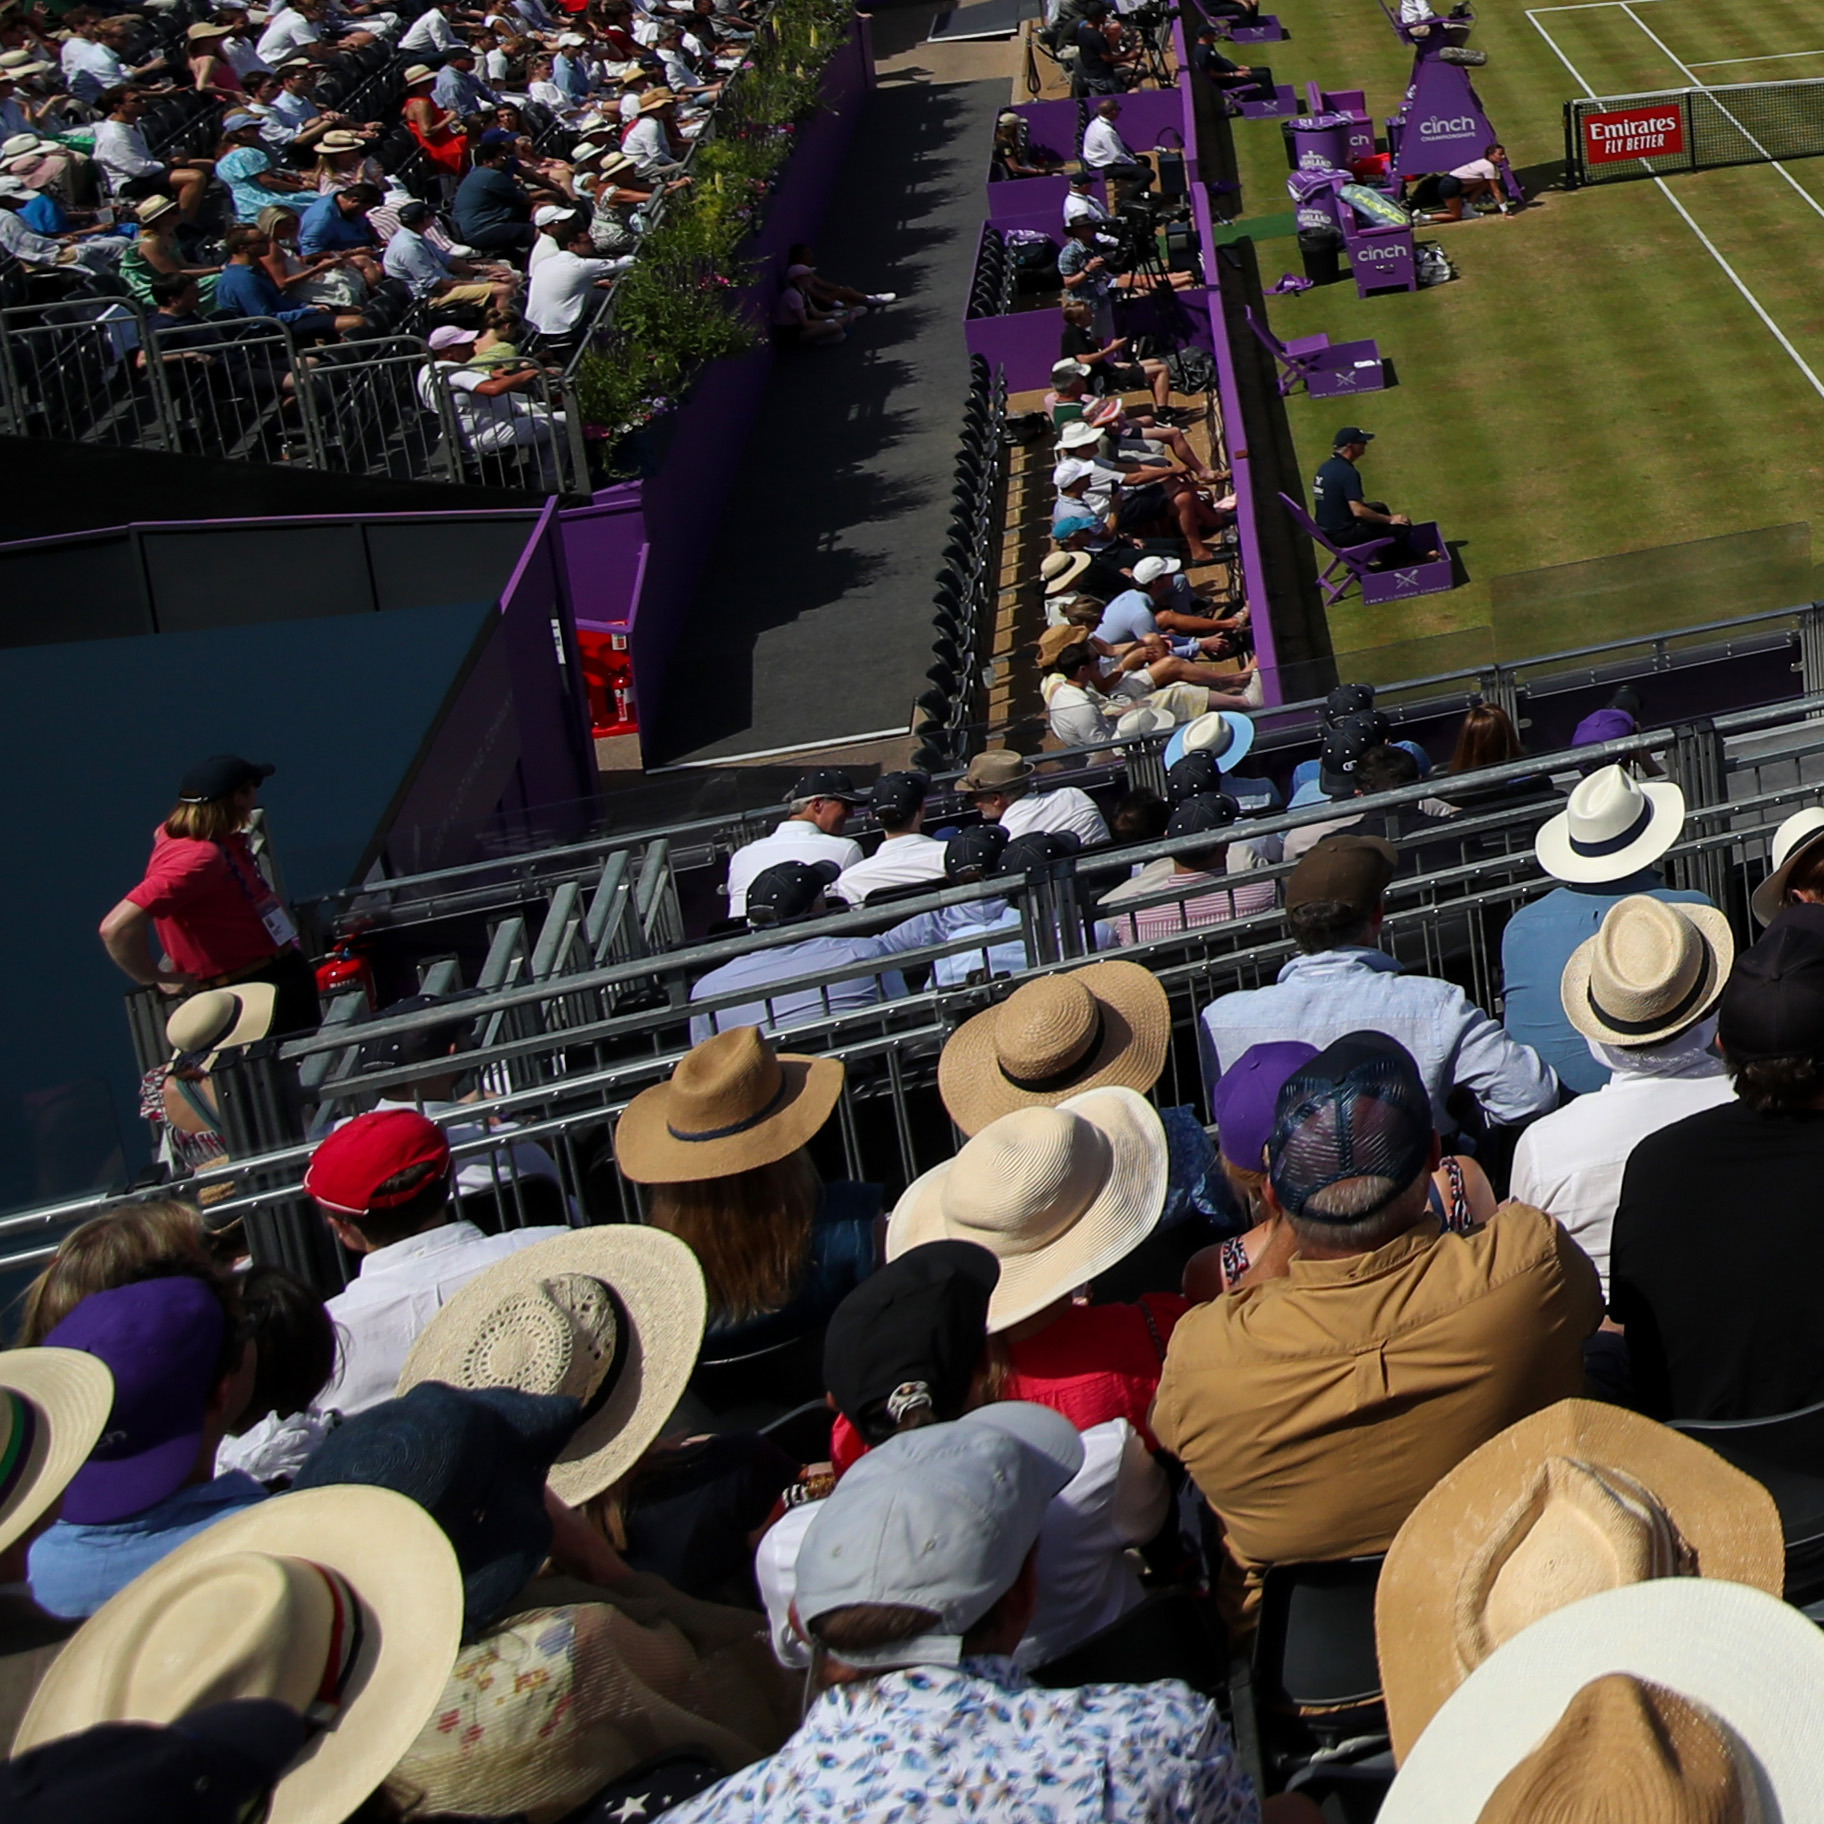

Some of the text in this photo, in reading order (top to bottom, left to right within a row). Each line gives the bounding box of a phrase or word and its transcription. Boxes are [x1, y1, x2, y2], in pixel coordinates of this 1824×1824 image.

[1420, 115, 1475, 135] cinch
[1590, 116, 1676, 141] Emirates
[1421, 132, 1476, 143] CHAMPIONSHIPS
[1604, 133, 1665, 154] FLY BETTER
[1358, 244, 1407, 262] cinch
